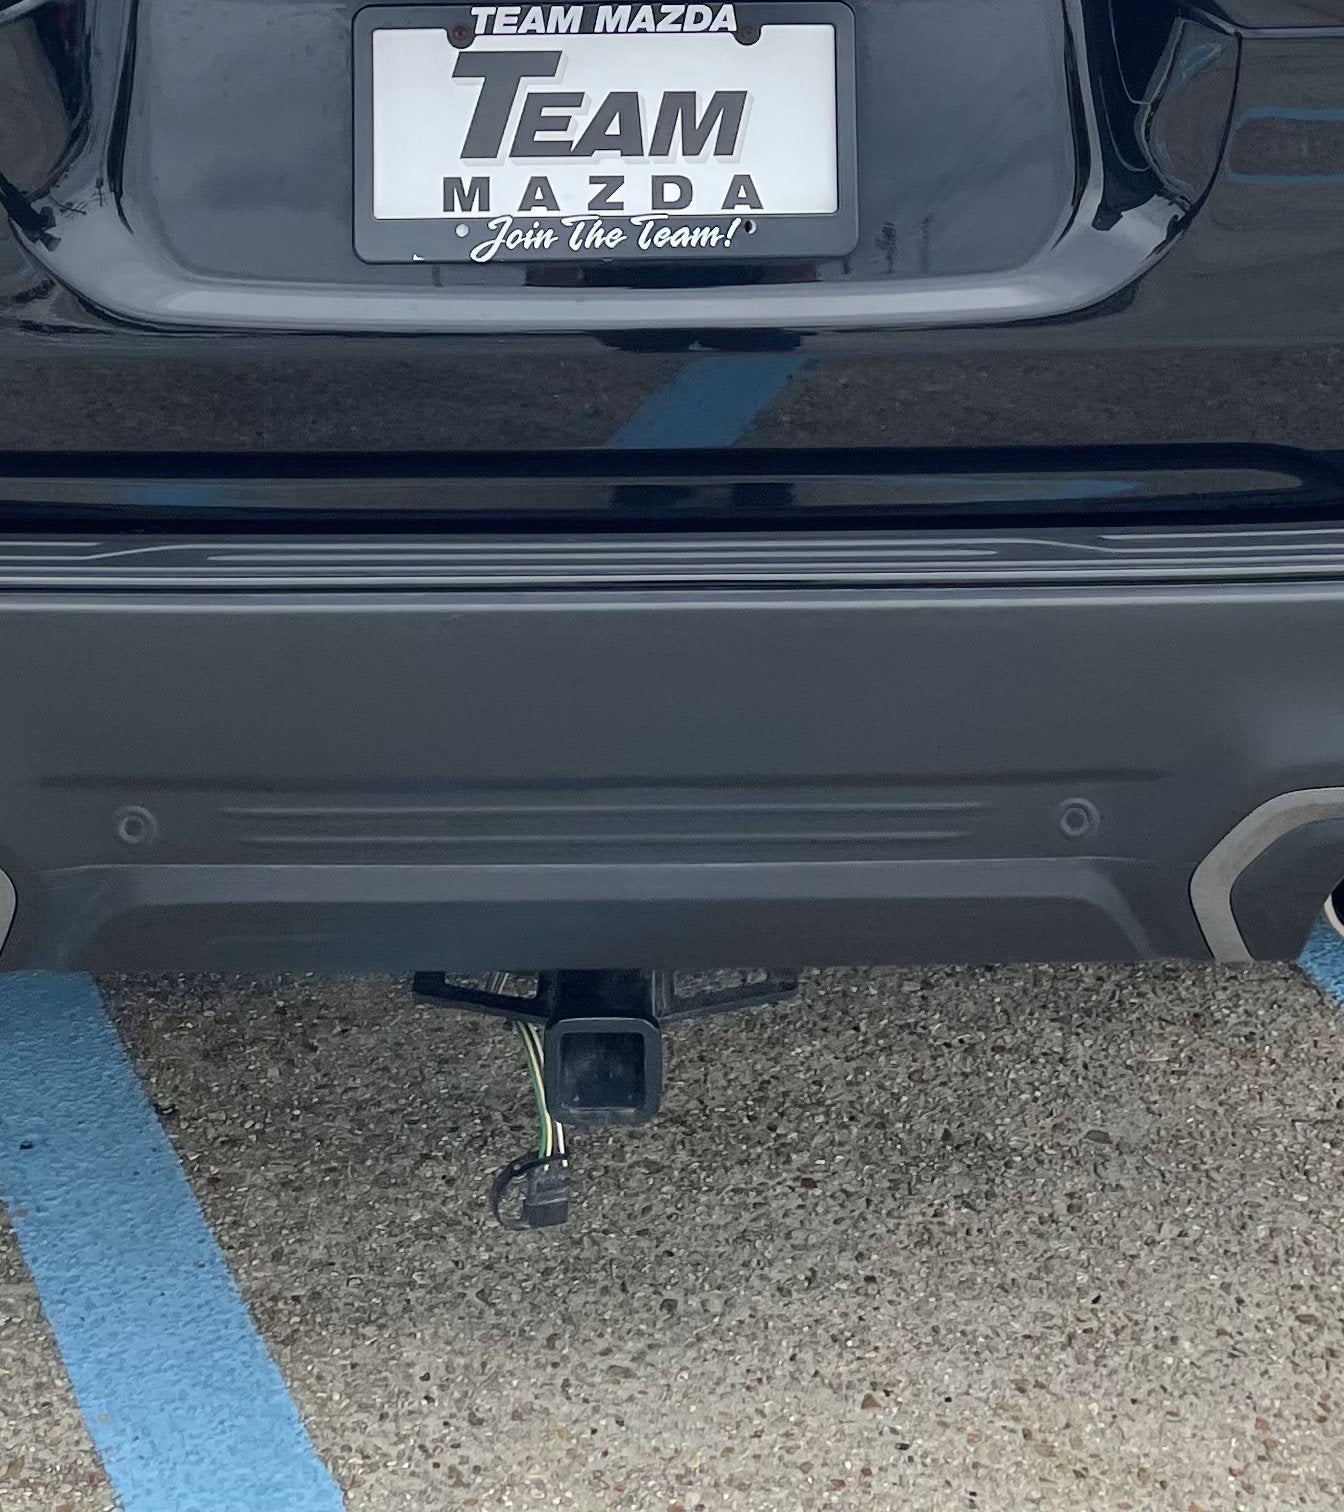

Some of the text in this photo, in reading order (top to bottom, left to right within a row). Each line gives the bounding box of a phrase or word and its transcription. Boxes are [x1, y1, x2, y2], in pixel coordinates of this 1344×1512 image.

[471, 4, 737, 35] TEAM MAZDA
[451, 50, 753, 162] TEAM
[442, 174, 764, 213] MAZDA
[470, 213, 741, 263] Join The Team!
